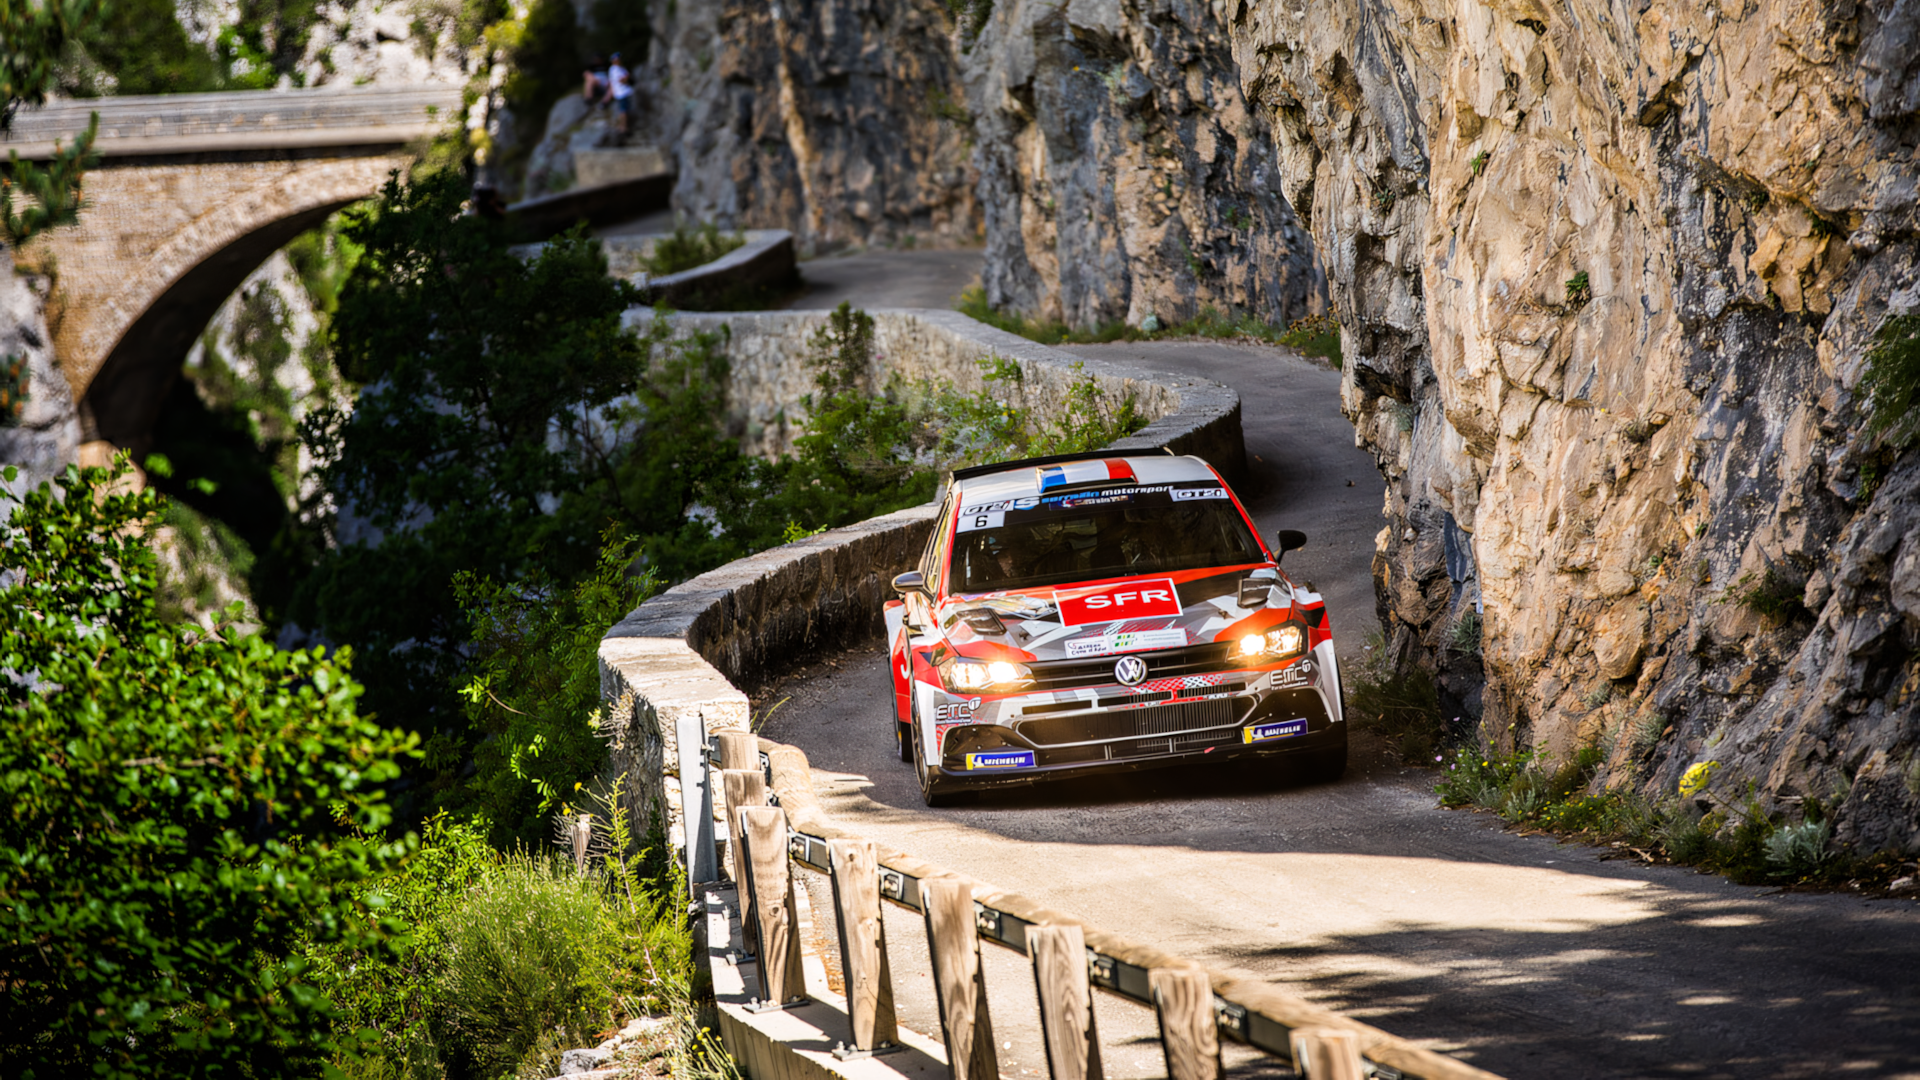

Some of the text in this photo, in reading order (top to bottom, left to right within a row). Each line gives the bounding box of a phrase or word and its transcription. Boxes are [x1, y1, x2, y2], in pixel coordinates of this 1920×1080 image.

[975, 515, 988, 528] 6
[1084, 589, 1171, 609] SFR
[984, 757, 1026, 765] MICHELIN
